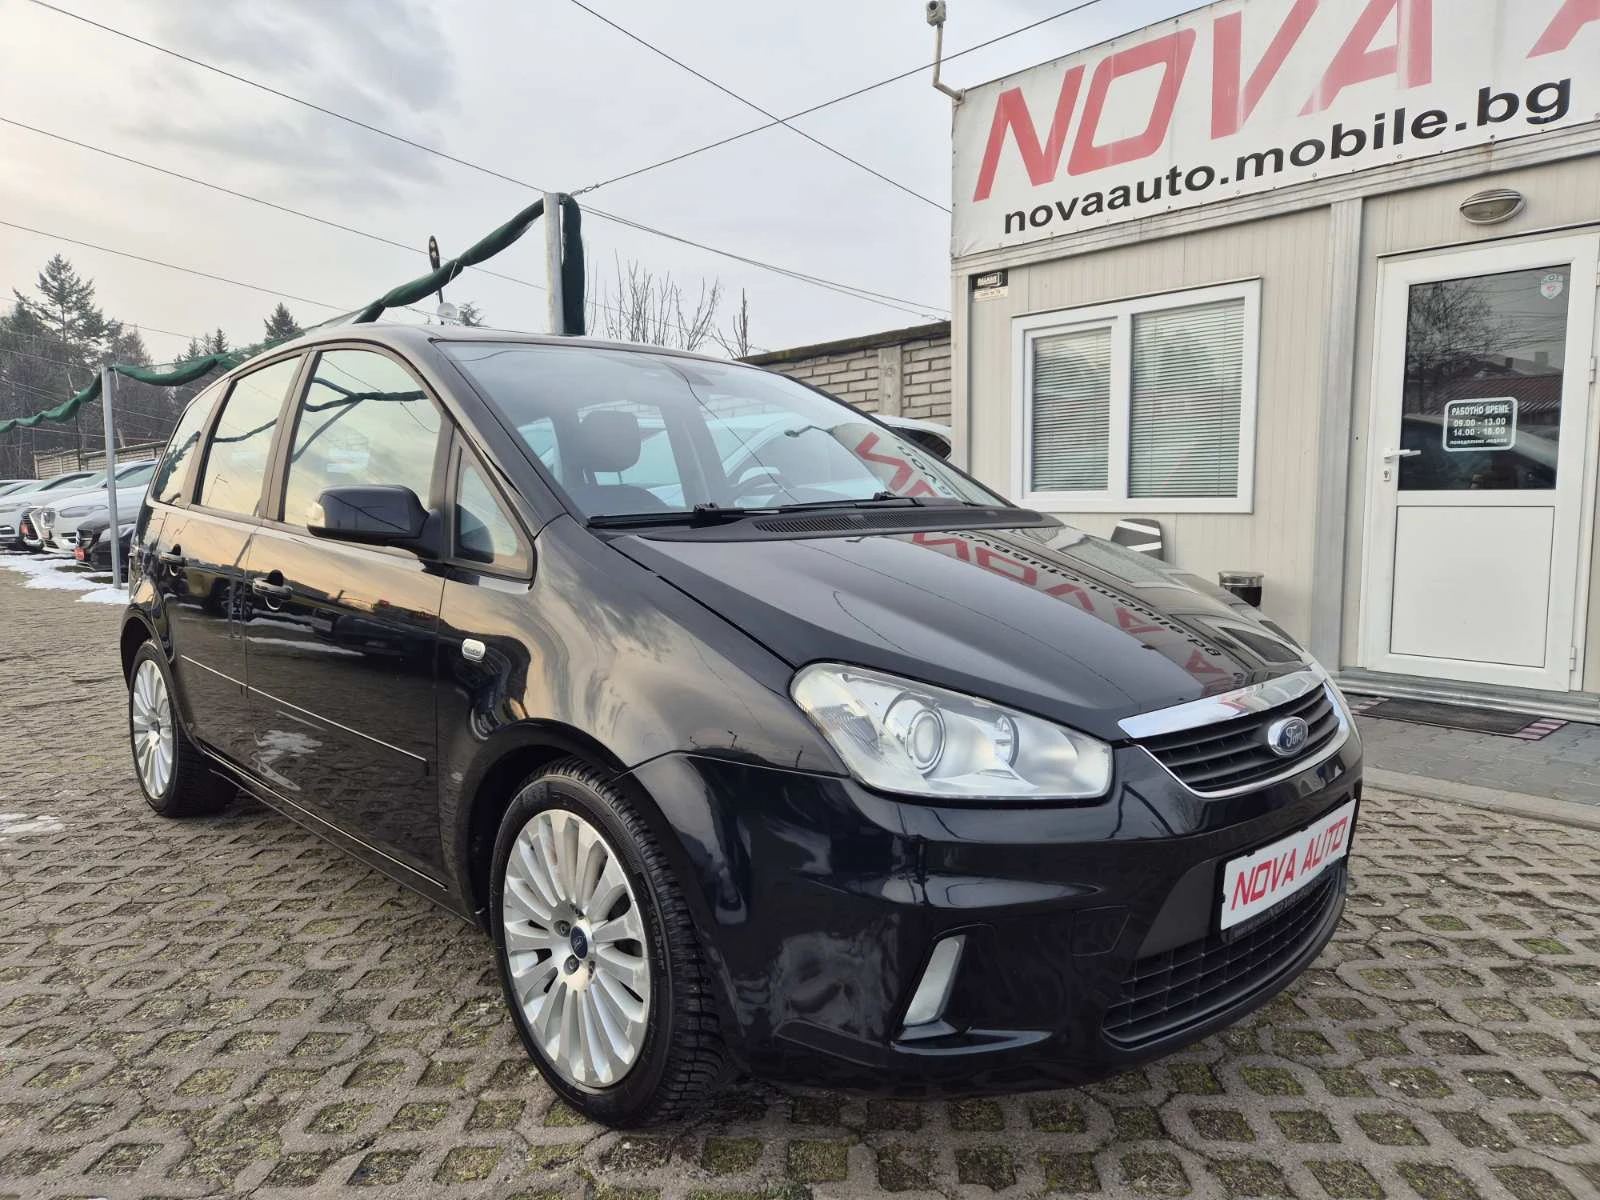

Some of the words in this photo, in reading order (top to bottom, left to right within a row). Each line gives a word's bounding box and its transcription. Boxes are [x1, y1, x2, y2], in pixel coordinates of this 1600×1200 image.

[973, 0, 1432, 202] NOVA
[1004, 78, 1570, 234] novaauto.mobile.bg
[1451, 406, 1484, 416] РАБОТНО
[1486, 404, 1510, 415] ВРЕМЕ
[1453, 428, 1475, 436] 14.00
[1484, 417, 1506, 425] 13.00
[1231, 848, 1297, 910] NOVA
[1301, 816, 1348, 876] AUTO
